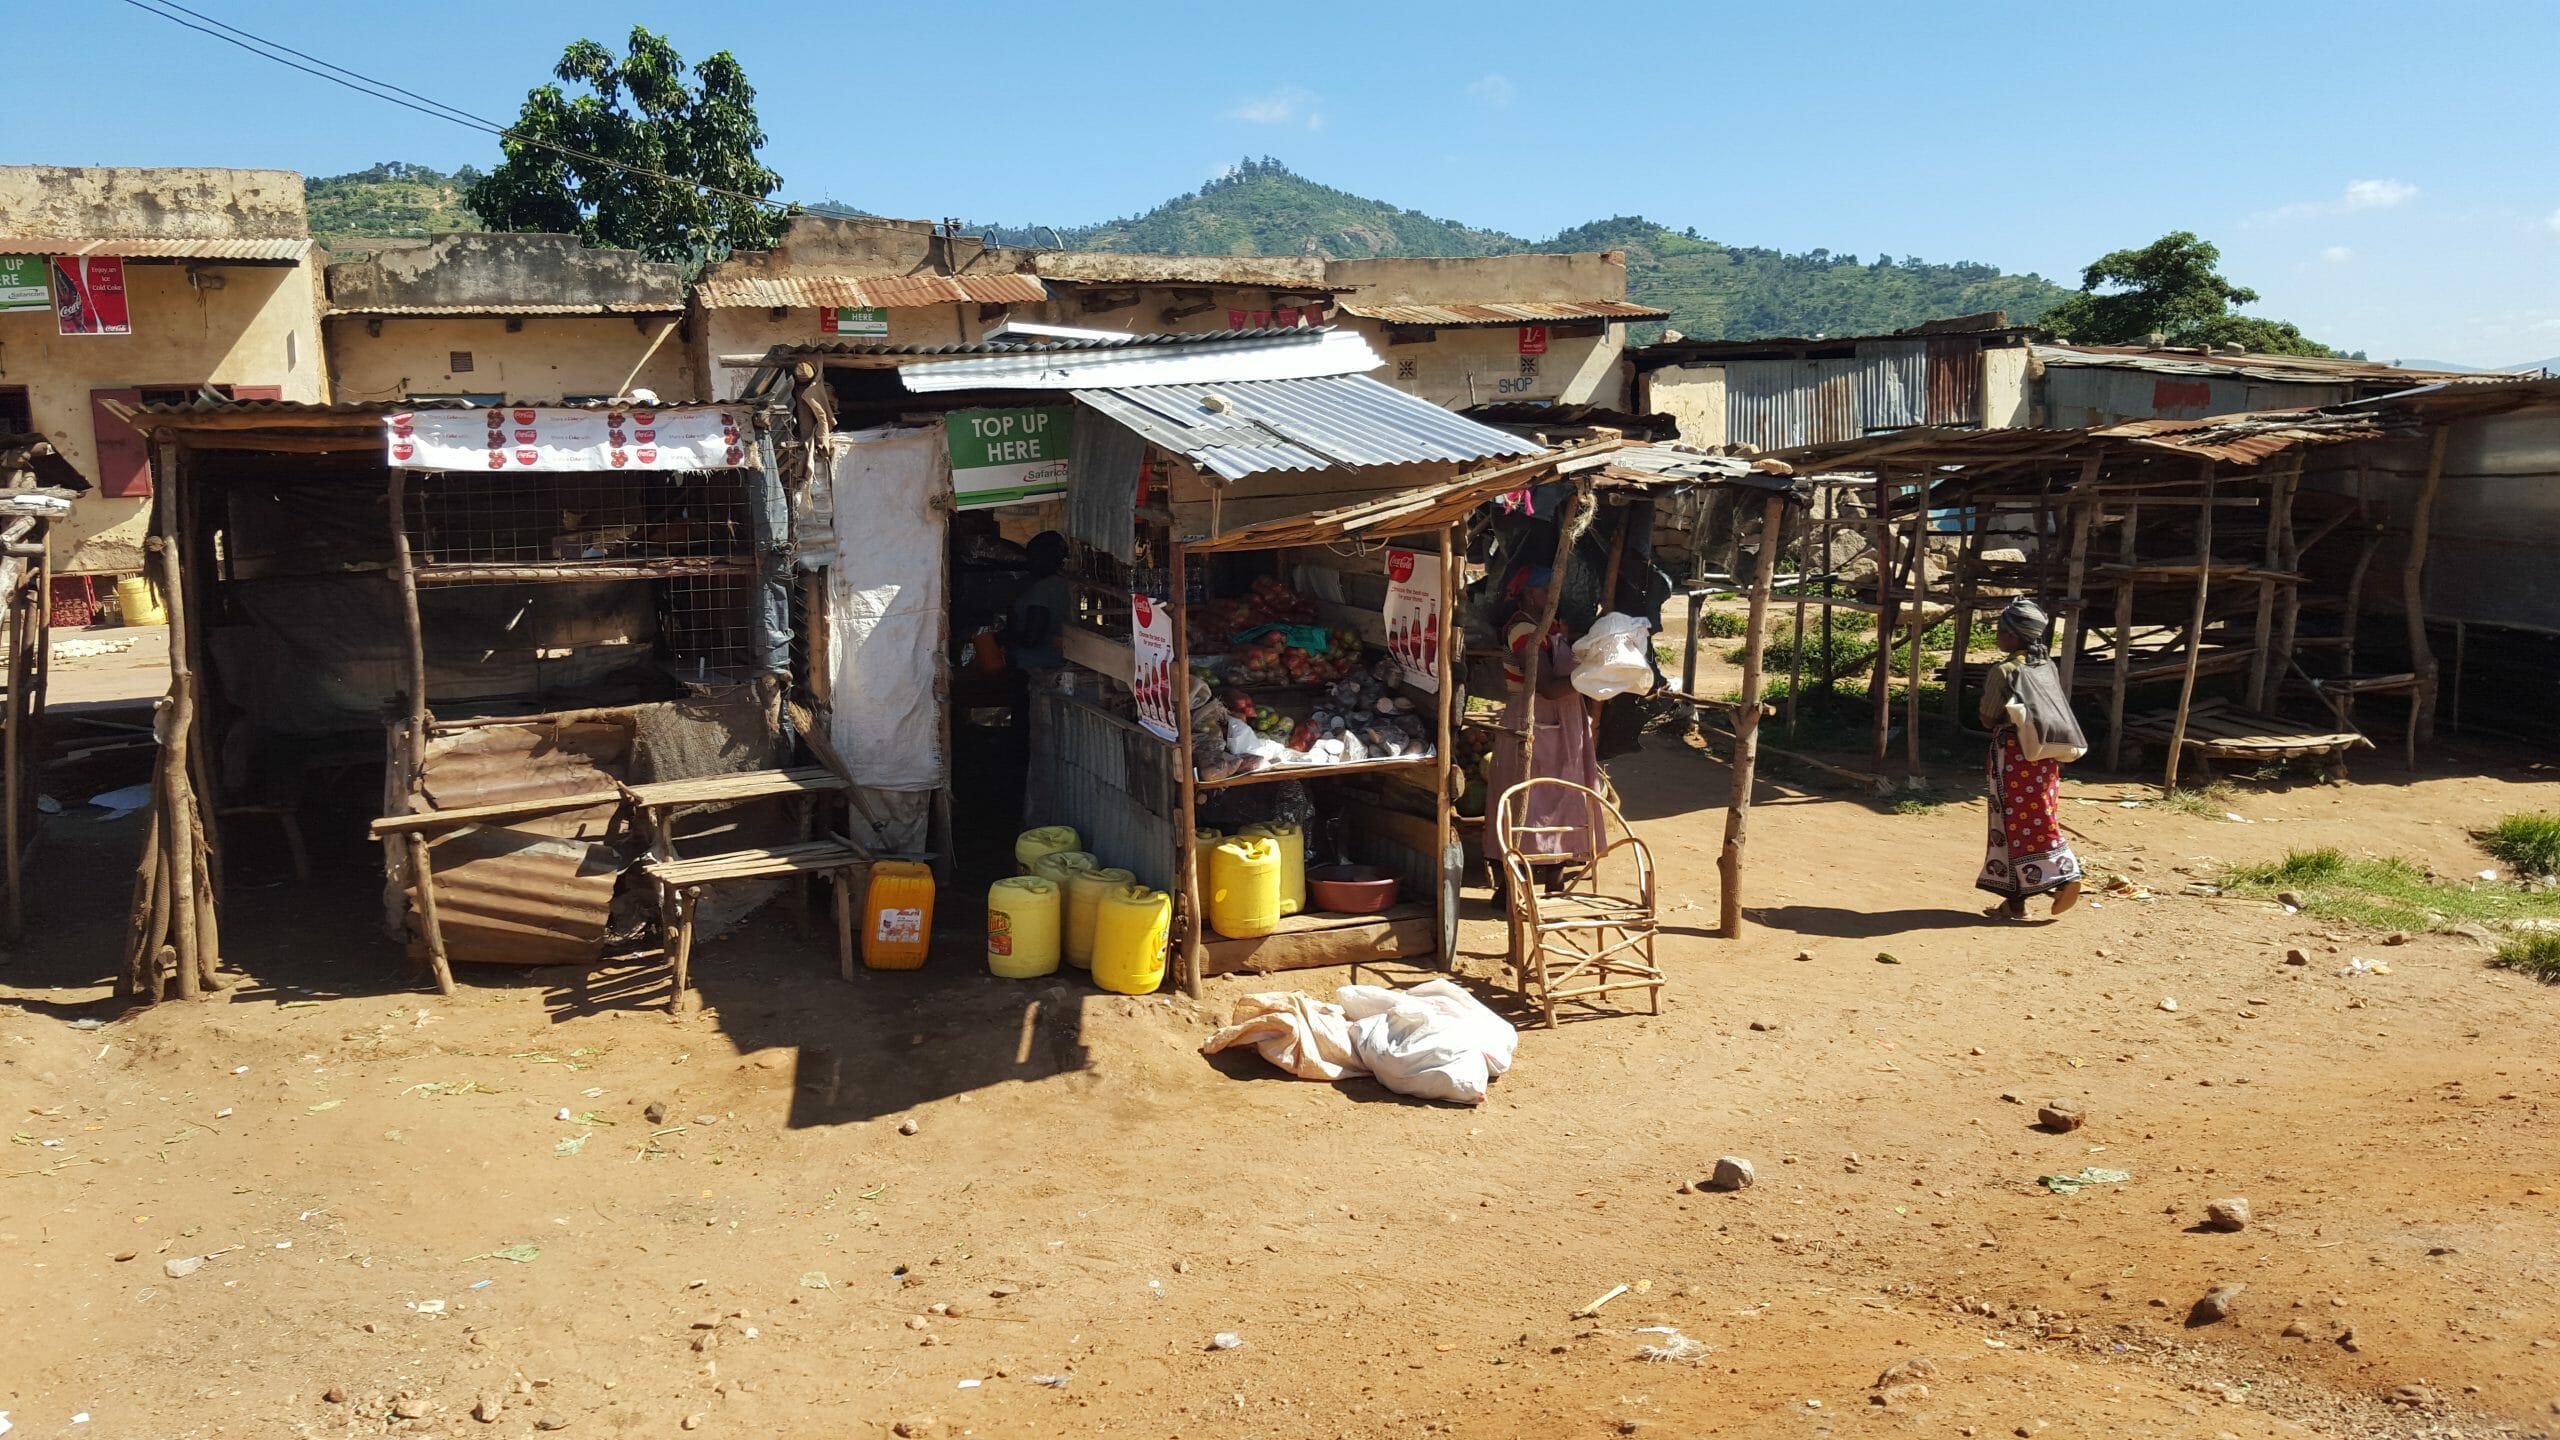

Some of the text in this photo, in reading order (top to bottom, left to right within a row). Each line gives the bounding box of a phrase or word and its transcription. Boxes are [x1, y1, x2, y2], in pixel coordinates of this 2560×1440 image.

[5, 259, 24, 271] UP
[0, 274, 20, 286] RE
[1499, 377, 1533, 393] SHOP
[971, 413, 1049, 438] TOP UP
[987, 439, 1041, 462] HERE
[1028, 470, 1068, 480] Safarico
[1390, 555, 1413, 570] Coca-Cola
